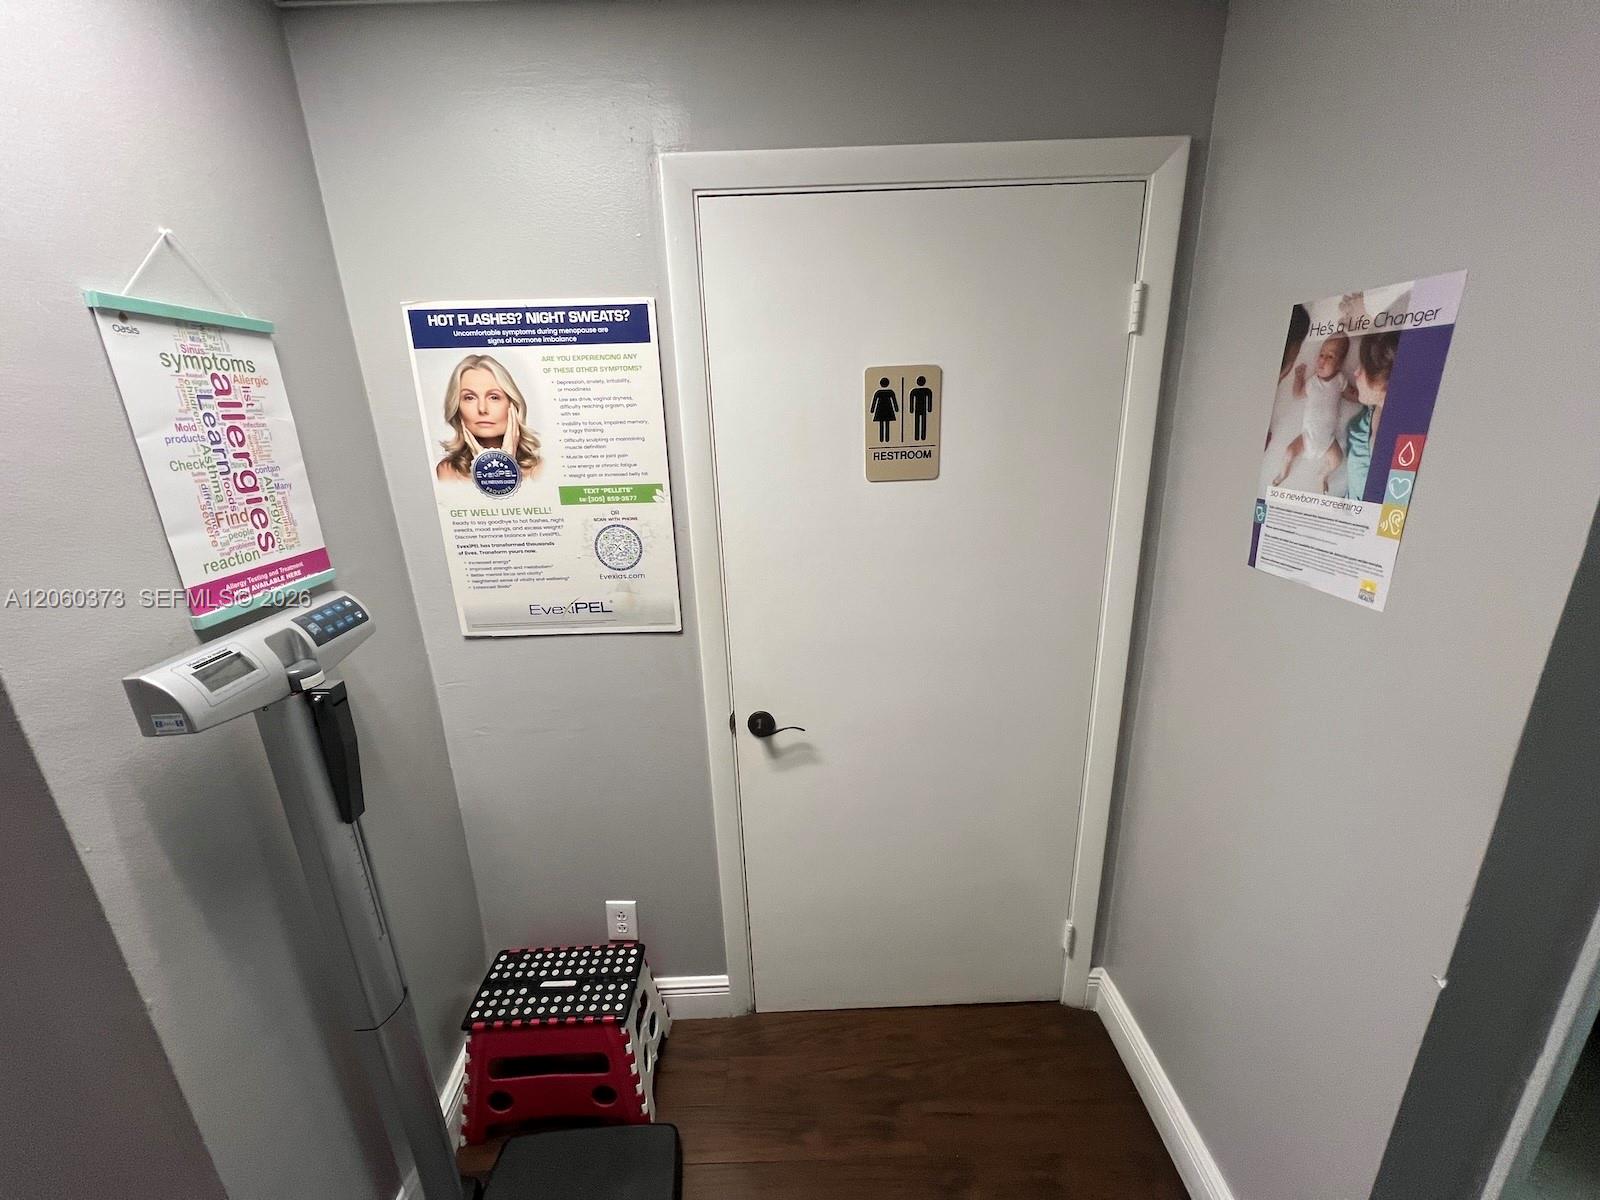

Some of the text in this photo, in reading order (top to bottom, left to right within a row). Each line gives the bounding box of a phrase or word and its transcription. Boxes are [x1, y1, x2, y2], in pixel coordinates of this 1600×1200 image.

[428, 310, 630, 326] HOT FLASHES? NIGHT SWEATS?
[1309, 307, 1442, 337] He's a Life Changer
[502, 328, 536, 336] symptoms
[537, 327, 557, 335] during
[180, 344, 205, 355] Sinus
[160, 352, 255, 374] symptoms
[233, 375, 268, 388] Allergic
[175, 422, 197, 432] Mold
[197, 394, 231, 476] Learn
[165, 434, 205, 445] products
[210, 372, 275, 552] allergies
[873, 450, 931, 460] RESTROOM
[170, 460, 206, 472] Check
[200, 444, 224, 503] Asthma
[263, 477, 283, 525] Allergy
[523, 507, 552, 515] WELL!
[1286, 492, 1320, 506] newborn
[1320, 497, 1363, 514] screening
[215, 507, 250, 528] Find
[228, 528, 254, 540] people
[203, 550, 260, 574] reaction
[225, 580, 246, 590] Allergy
[247, 572, 268, 584] Testing
[279, 562, 304, 573] Treatment
[252, 576, 285, 592] AVAILABLE
[286, 570, 302, 580] HERE
